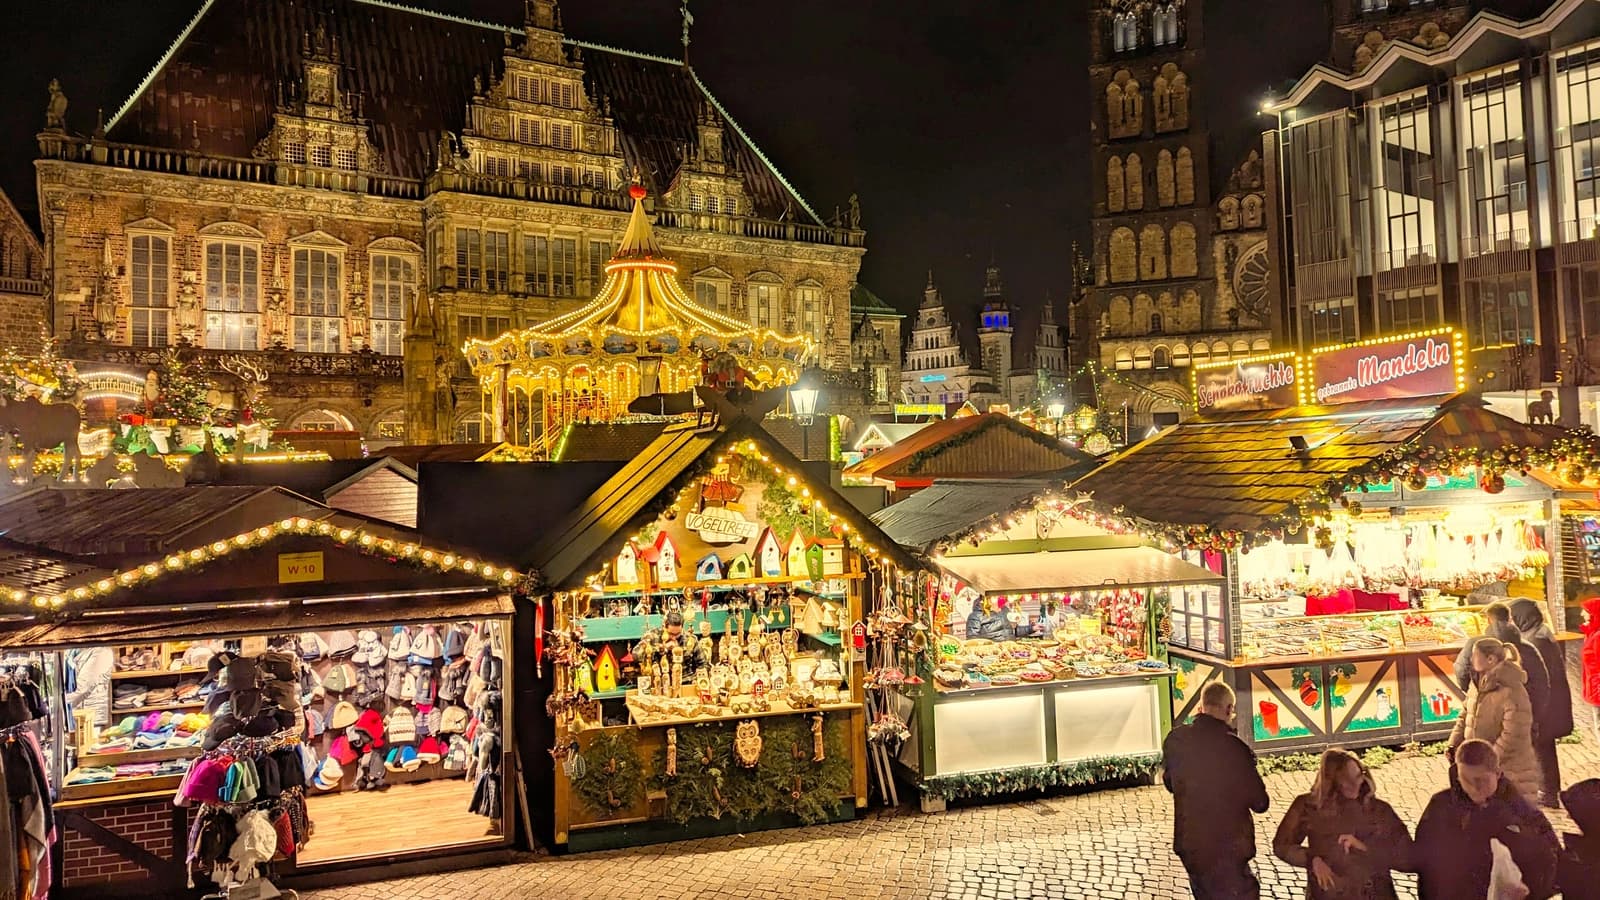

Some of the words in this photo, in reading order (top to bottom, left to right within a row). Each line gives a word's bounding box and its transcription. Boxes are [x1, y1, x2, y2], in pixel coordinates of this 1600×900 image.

[1317, 377, 1358, 402] gebrannte
[1357, 338, 1450, 387] Mandeln
[84, 377, 144, 395] artoffelpuffer
[687, 514, 755, 536] VOGELTREFF
[288, 565, 299, 574] W
[304, 564, 315, 574] 10
